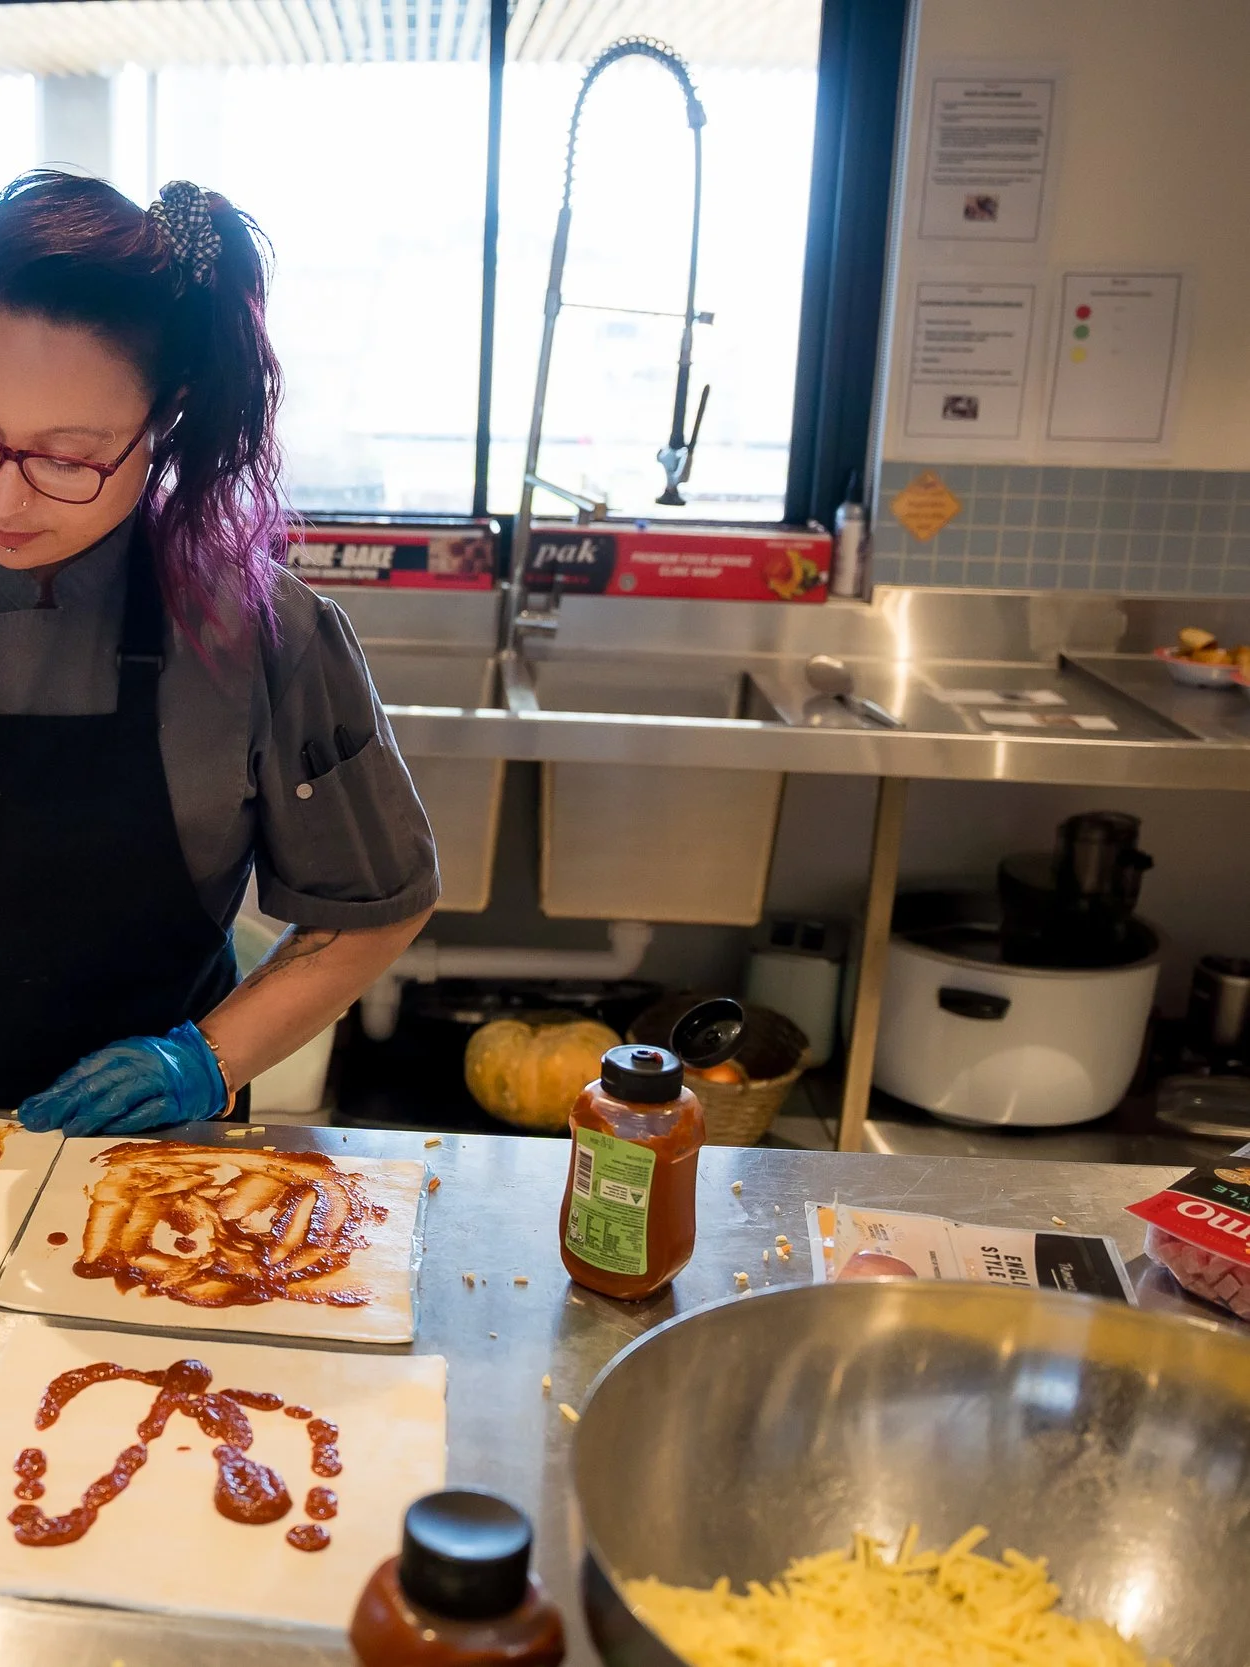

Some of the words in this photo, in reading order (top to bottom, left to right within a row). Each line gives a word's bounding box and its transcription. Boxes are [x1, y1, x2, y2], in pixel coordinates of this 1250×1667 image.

[534, 539, 597, 568] pak
[1212, 1184, 1250, 1205] YLE
[981, 1246, 1007, 1279] STYLE
[1004, 1255, 1031, 1286] ENGLI
